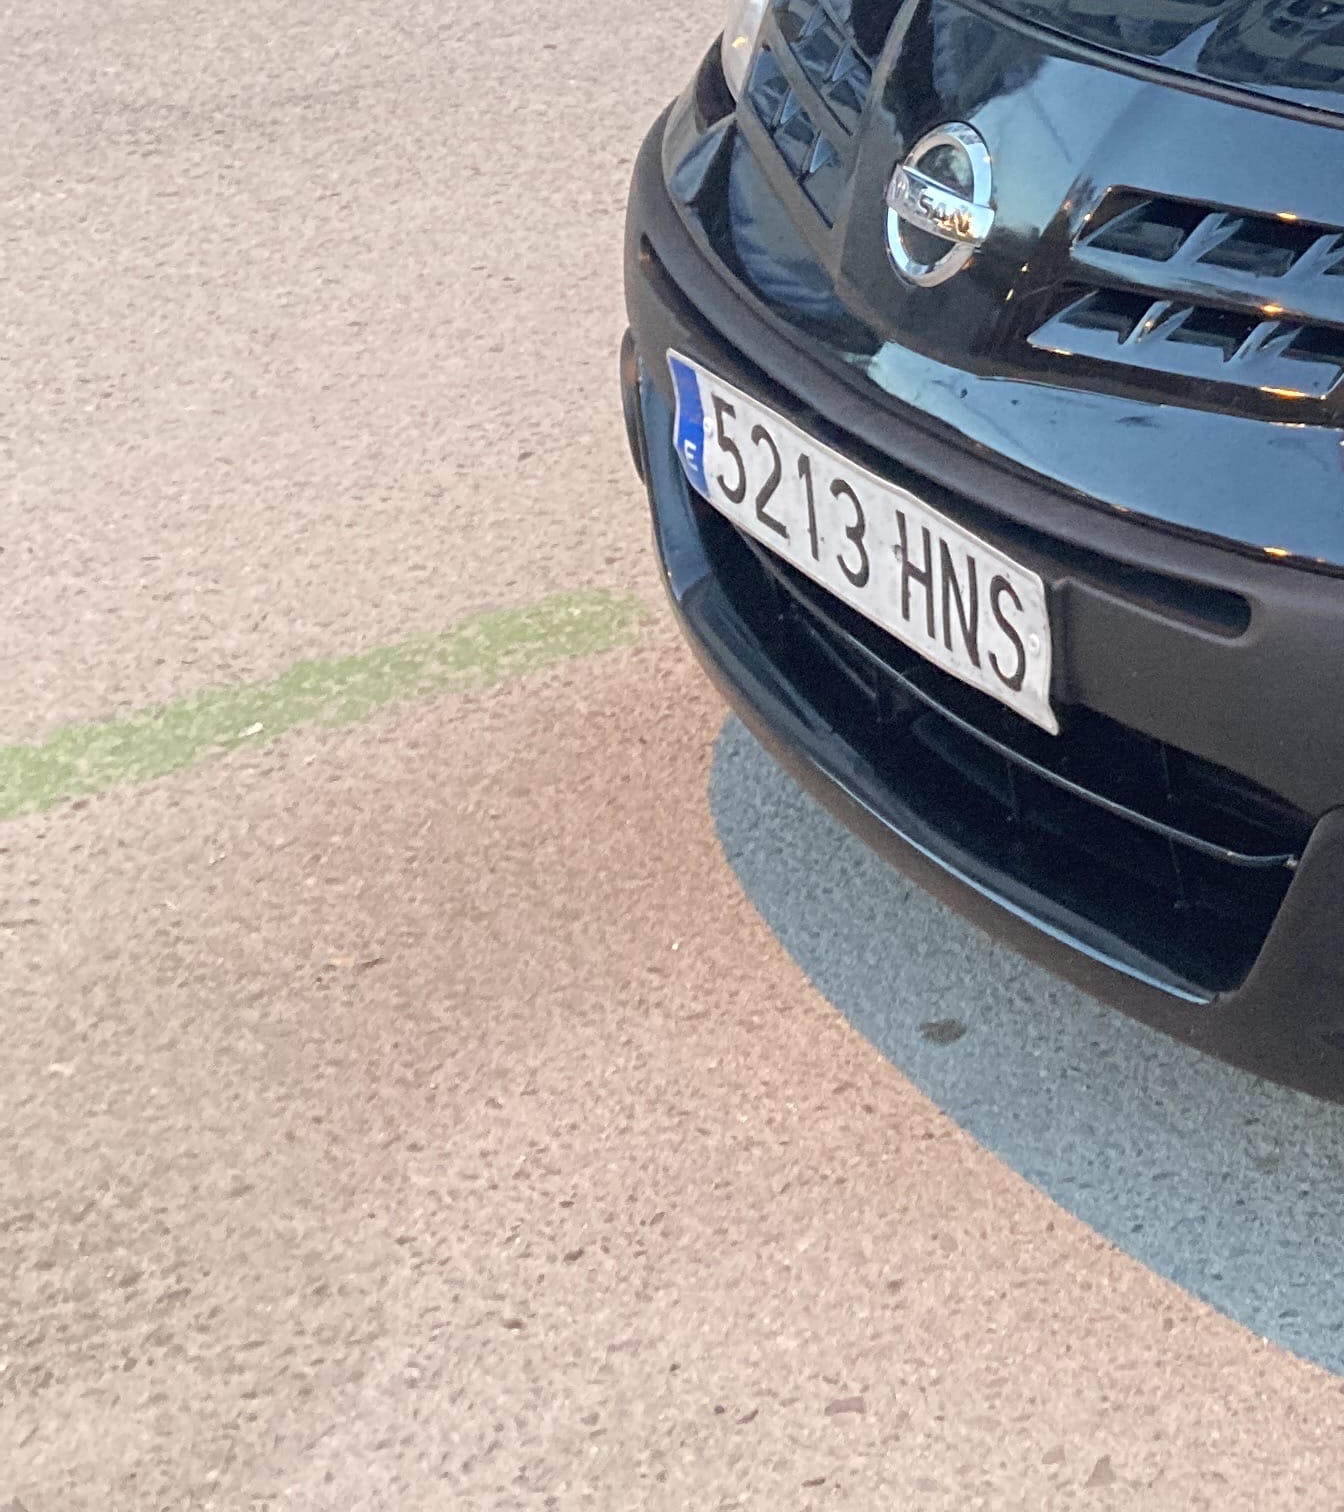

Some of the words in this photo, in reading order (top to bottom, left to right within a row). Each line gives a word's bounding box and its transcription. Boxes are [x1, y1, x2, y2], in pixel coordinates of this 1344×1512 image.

[684, 439, 698, 472] E
[712, 392, 870, 588] 5213
[896, 510, 1026, 692] HNS
